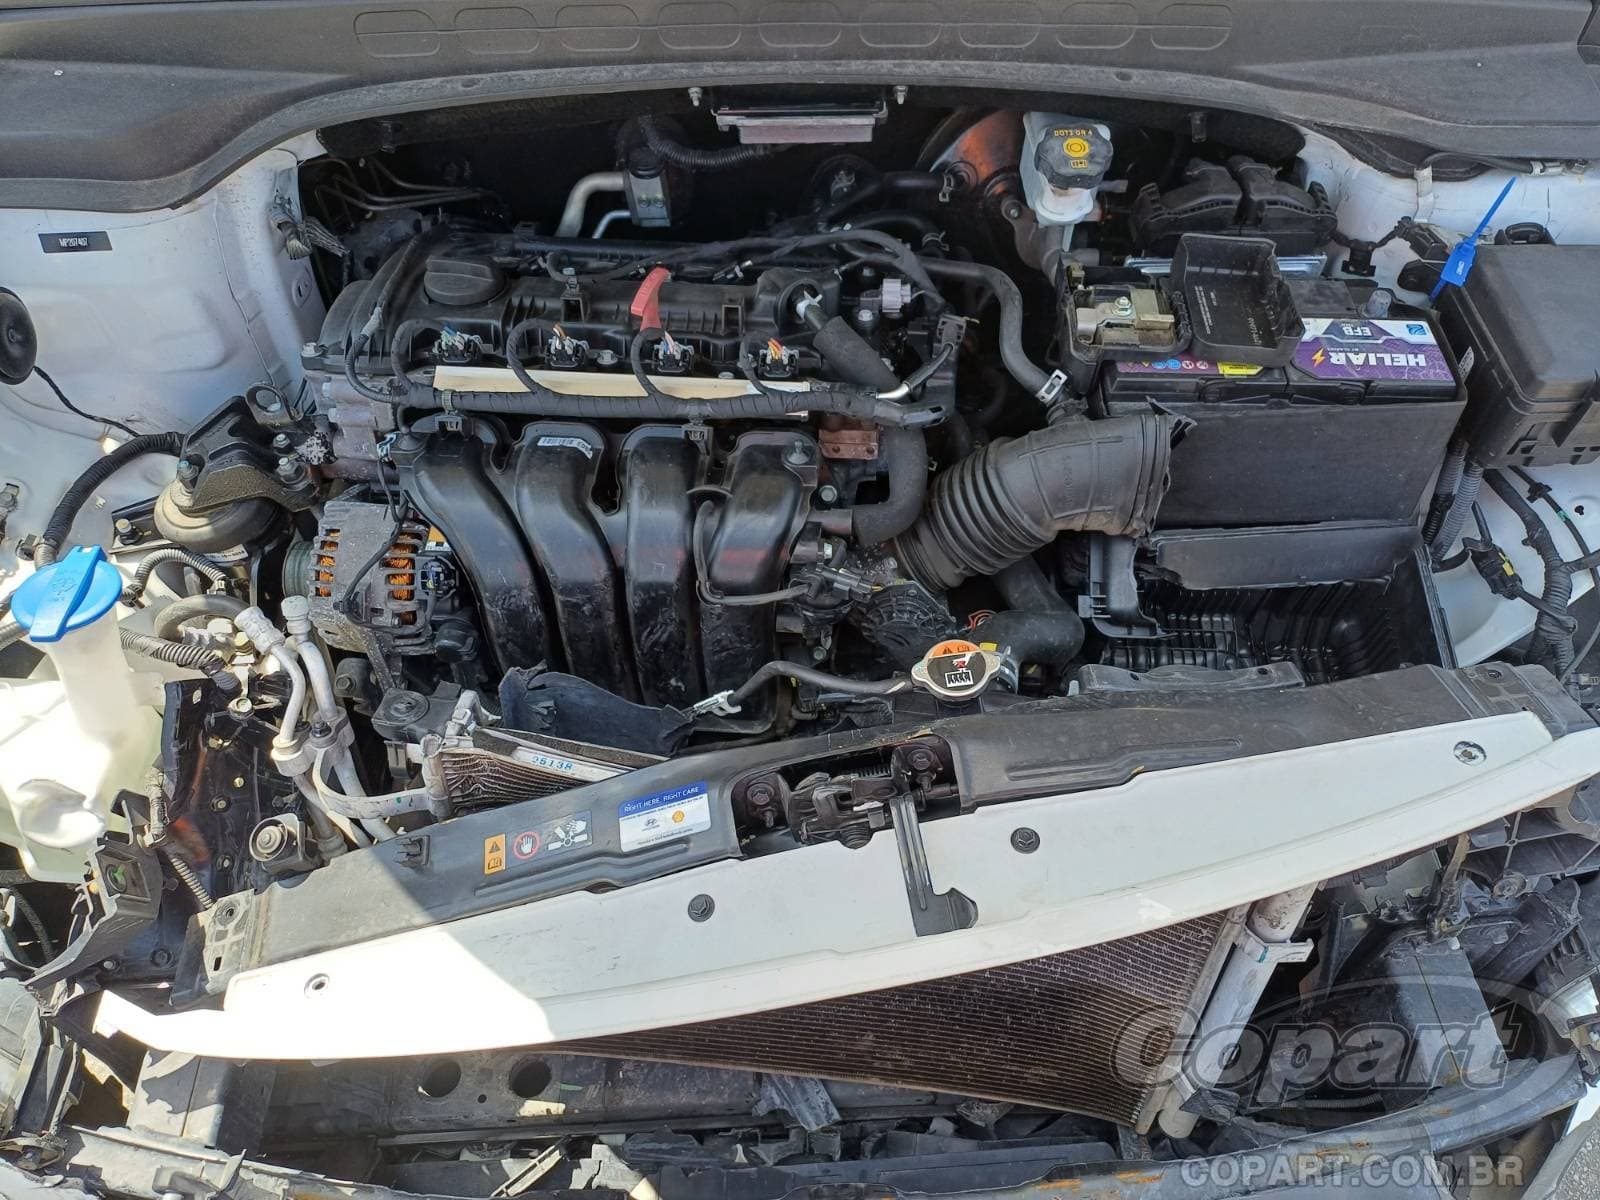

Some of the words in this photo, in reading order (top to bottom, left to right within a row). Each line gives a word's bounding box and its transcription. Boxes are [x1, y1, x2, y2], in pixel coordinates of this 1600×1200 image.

[1342, 326, 1373, 337] EFB
[1328, 352, 1427, 367] HELIAR
[624, 802, 643, 812] RIGHT
[663, 791, 682, 802] RIGHT
[682, 786, 700, 796] CARE
